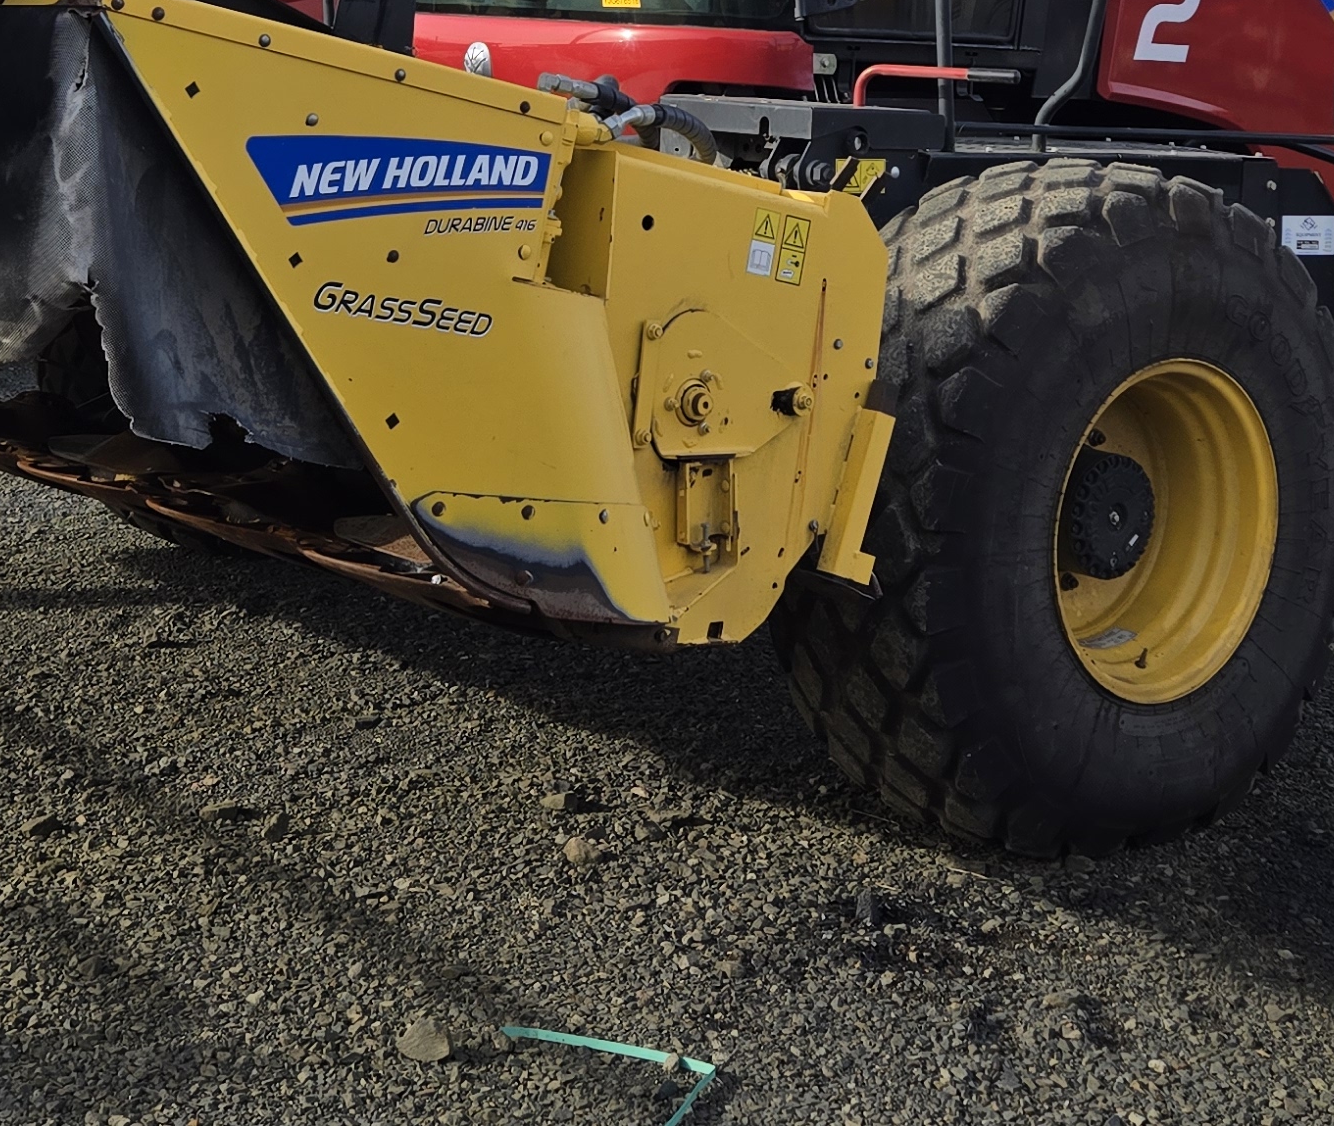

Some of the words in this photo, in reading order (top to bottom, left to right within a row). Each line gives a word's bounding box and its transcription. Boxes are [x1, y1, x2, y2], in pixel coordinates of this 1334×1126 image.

[288, 156, 382, 199] NEW
[382, 154, 539, 190] HOLLAND
[424, 215, 515, 235] DURABINE
[515, 219, 537, 232] 416
